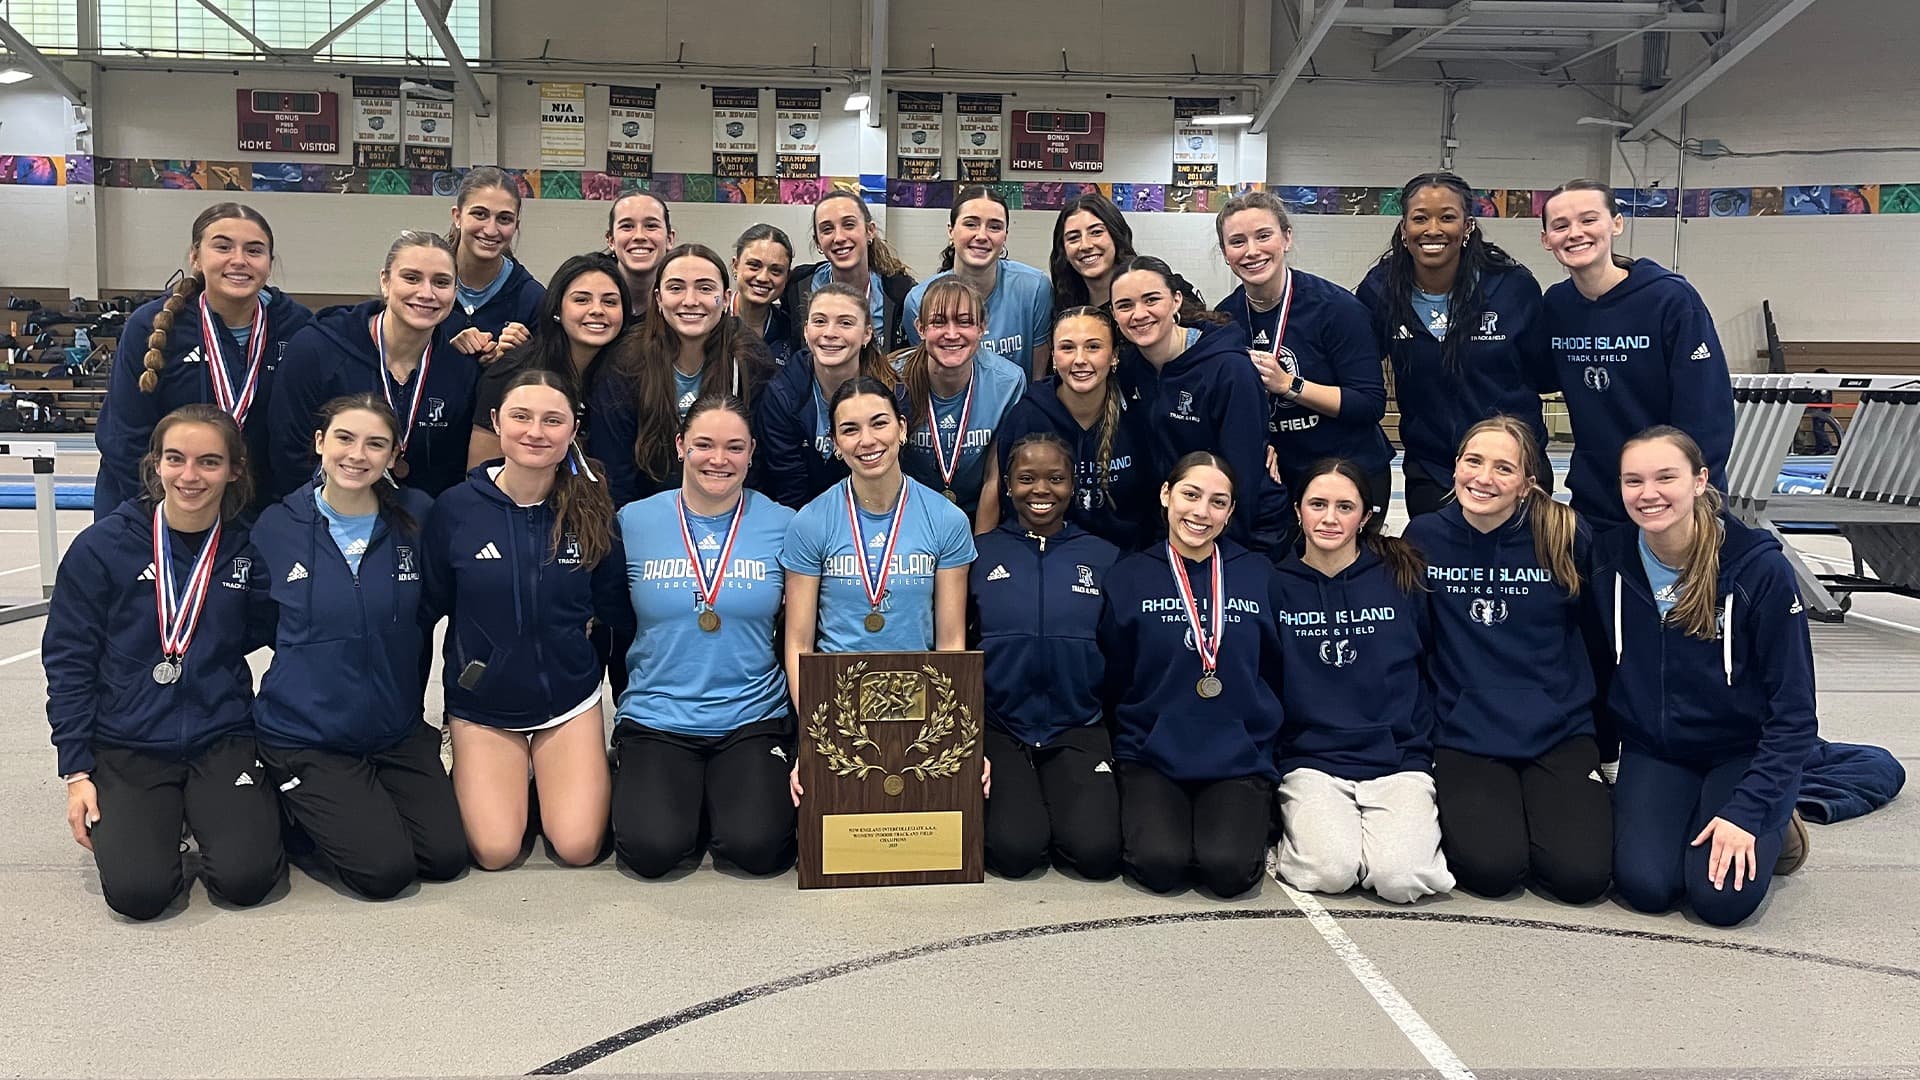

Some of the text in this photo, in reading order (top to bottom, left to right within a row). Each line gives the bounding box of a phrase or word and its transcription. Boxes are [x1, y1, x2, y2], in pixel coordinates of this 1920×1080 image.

[552, 104, 574, 113] NIA
[542, 115, 584, 123] HOWARD
[240, 140, 272, 150] HOME
[300, 142, 336, 151] VISITOR
[625, 142, 651, 150] METERS
[412, 148, 444, 156] CHAMPION
[627, 155, 648, 163] PLACE
[1013, 160, 1043, 168] HOME
[1069, 162, 1103, 170] VISITOR
[1551, 336, 1650, 350] RHODE ISLAND
[1269, 415, 1319, 432] & FIELD
[888, 553, 935, 575] SLAND
[643, 559, 694, 580] RHODE
[1427, 566, 1551, 582] RHODE ISLAND
[222, 581, 242, 590] TRACK
[656, 581, 698, 589] TRACK
[1072, 585, 1086, 593] TRACK
[1486, 586, 1494, 594] &
[1280, 607, 1395, 625] RHODE ISLAND
[1295, 629, 1328, 637] TRACK
[1334, 628, 1340, 636] &
